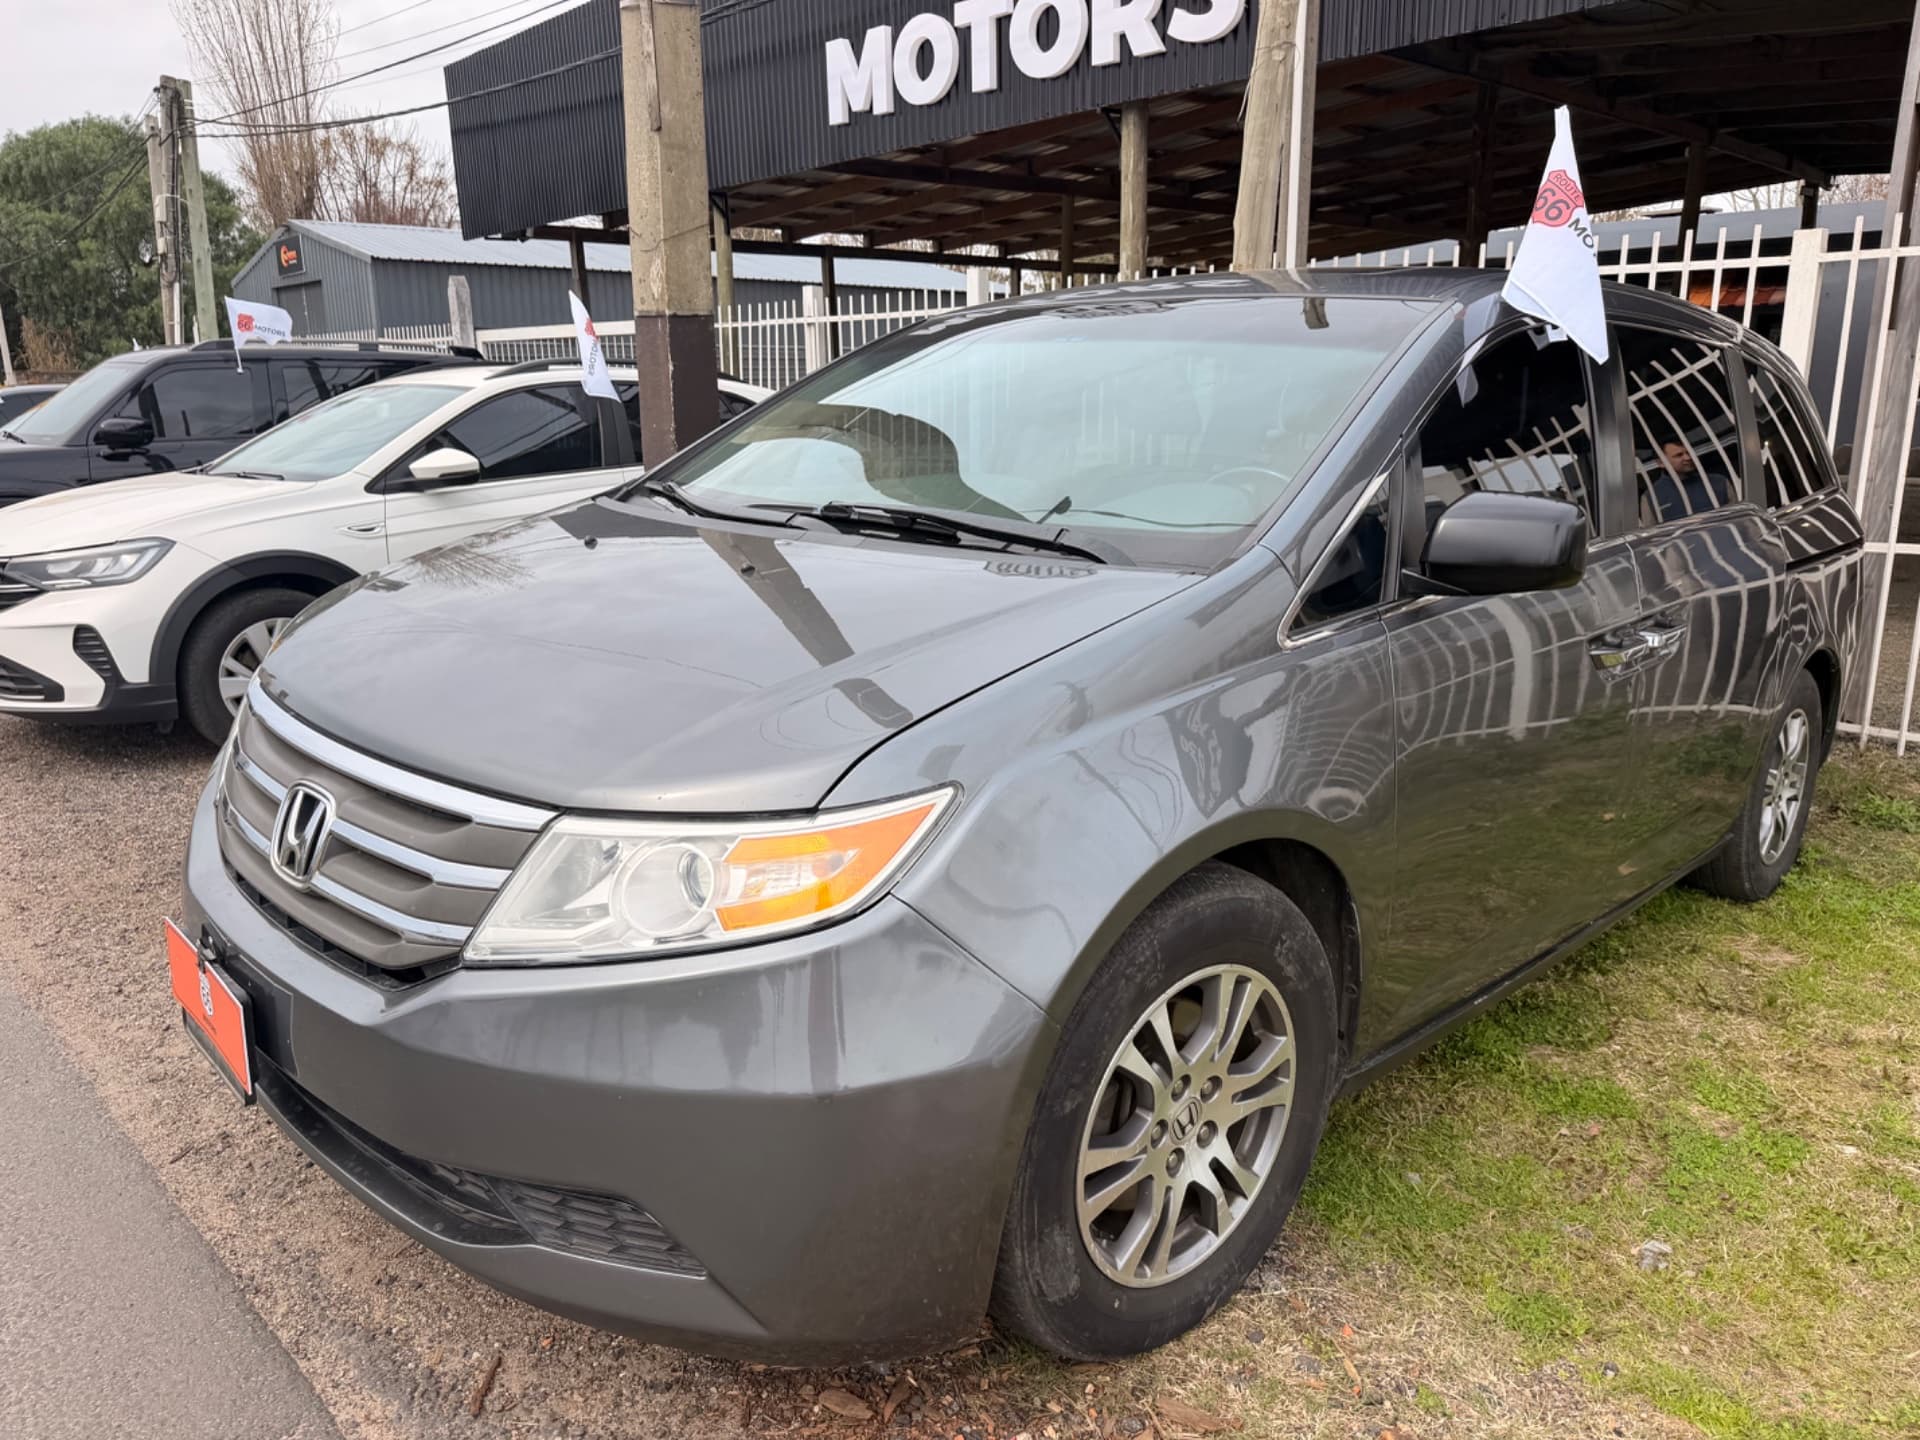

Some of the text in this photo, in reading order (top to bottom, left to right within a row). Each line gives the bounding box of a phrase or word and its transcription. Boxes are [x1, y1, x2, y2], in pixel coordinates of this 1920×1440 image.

[1553, 173, 1582, 202] ROUTE
[1535, 188, 1571, 221] 66
[255, 323, 286, 337] MOTORS
